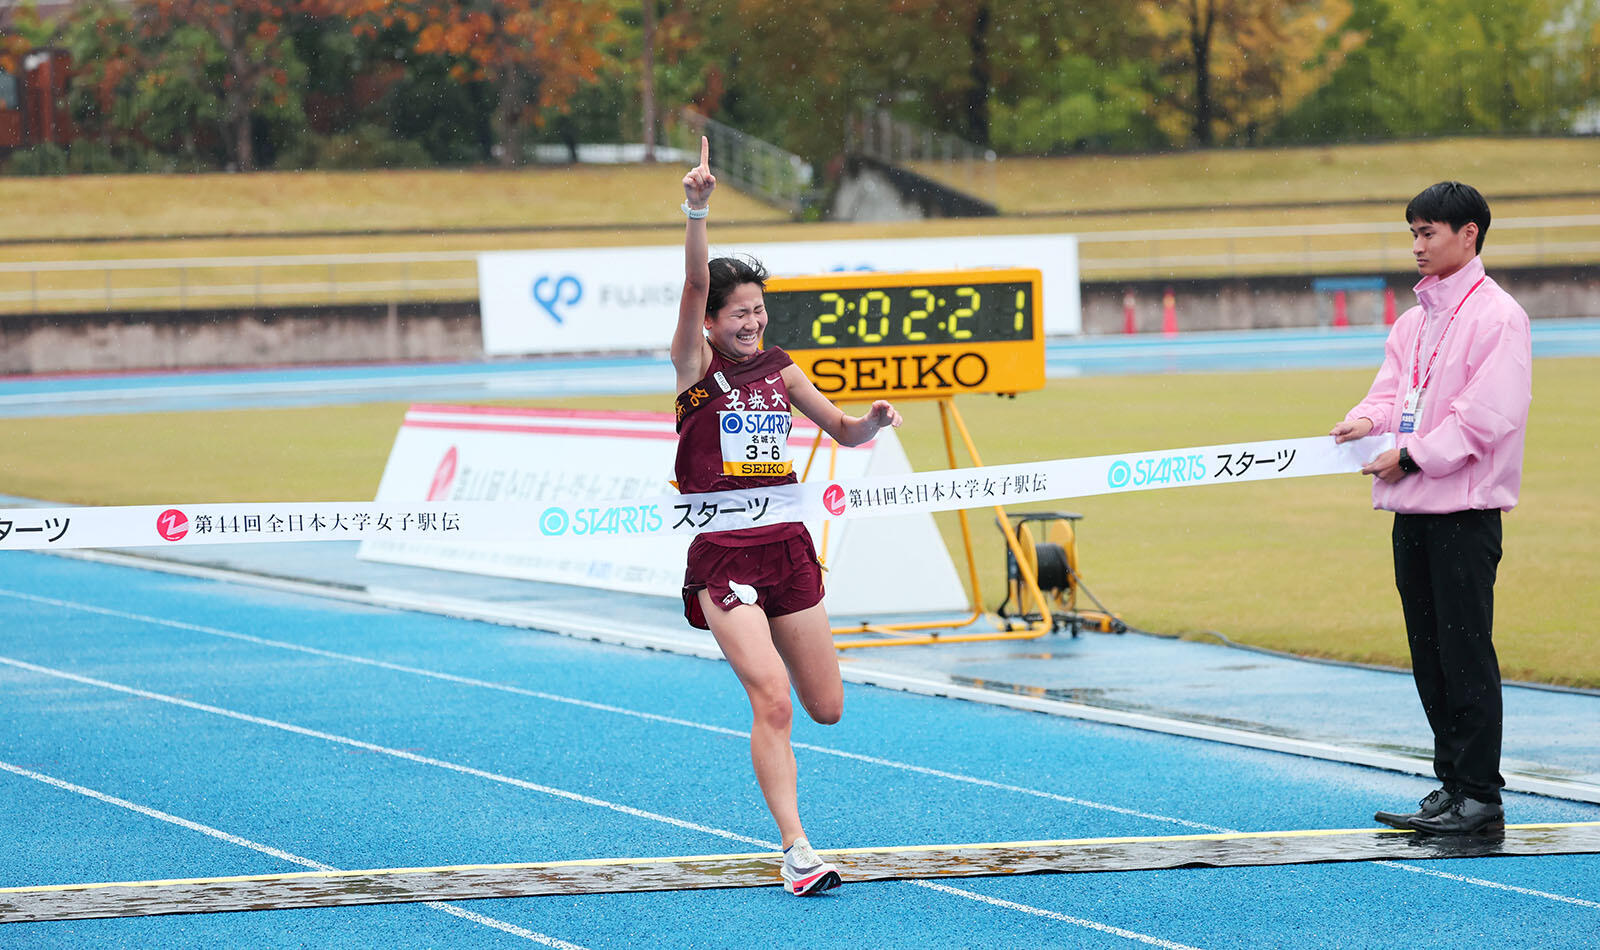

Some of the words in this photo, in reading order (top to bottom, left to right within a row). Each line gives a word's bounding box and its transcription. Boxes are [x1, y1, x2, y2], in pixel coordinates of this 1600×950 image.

[812, 353, 988, 392] SEIKO
[725, 389, 788, 411] 名城大
[752, 435, 776, 443] 名城大
[746, 445, 780, 460] 3-6
[741, 463, 785, 474] SEIKO
[194, 512, 460, 535] 第44回全日本大学女子駅伝
[572, 504, 663, 535] STARTS
[673, 497, 769, 529] スターツ
[849, 473, 1048, 508] 第44回全日本大学女子駅伝
[1133, 455, 1206, 486] STARTS
[1214, 449, 1296, 477] スターツ
